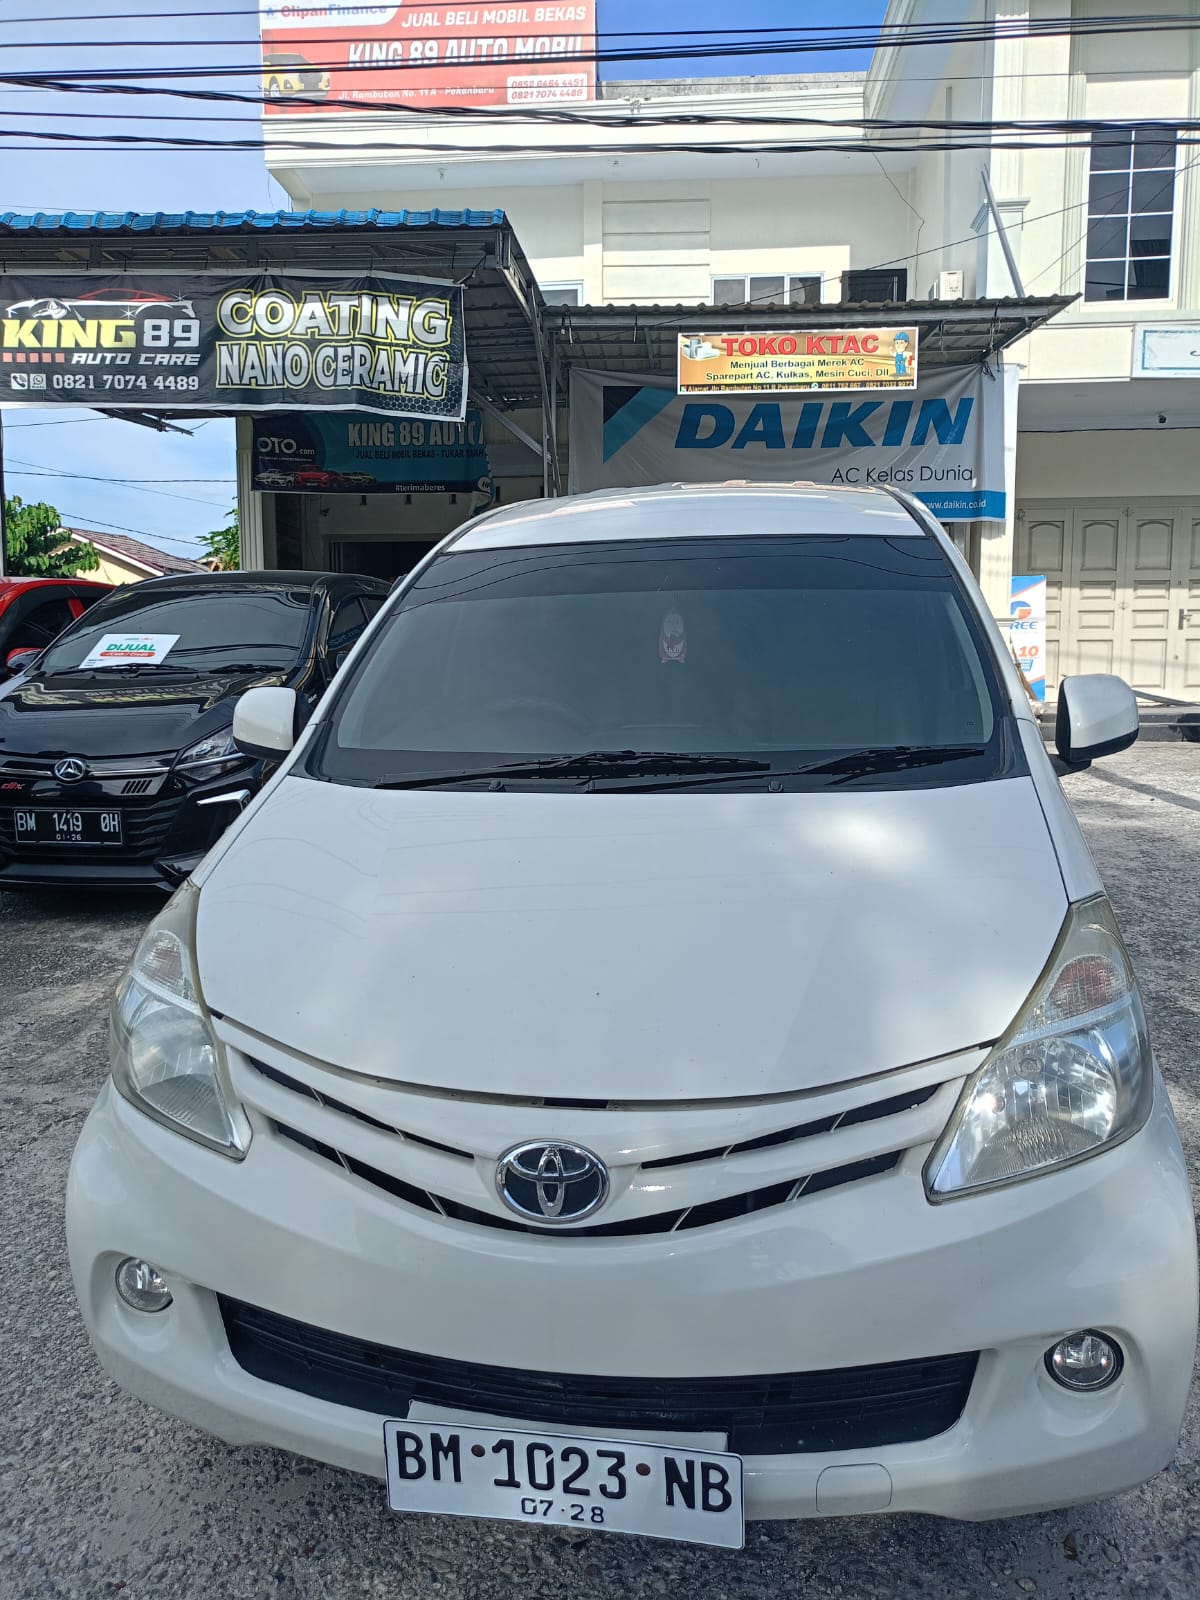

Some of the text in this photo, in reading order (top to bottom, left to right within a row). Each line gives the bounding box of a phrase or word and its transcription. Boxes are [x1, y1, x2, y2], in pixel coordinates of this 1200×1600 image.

[401, 6, 587, 27] JUAL BELI MOBIL BEKAS
[348, 41, 403, 68] KING
[408, 39, 440, 66] 89
[444, 37, 509, 64] AUTO
[217, 288, 453, 347] COATING
[2, 318, 200, 348] KING 89
[721, 334, 880, 357] TOKO KTAC
[72, 352, 201, 366] AUTO CARE
[730, 358, 865, 371] Menjual Berbagai Merek AC
[216, 341, 449, 400] NANO CERAMIC
[706, 370, 753, 381] Sparepart
[816, 369, 845, 378] Mesin
[53, 374, 199, 390] 0821 7074 4489
[675, 398, 975, 448] DAIKIN
[348, 423, 395, 447] KING
[399, 422, 425, 446] 89
[831, 465, 973, 483] AC Kelas Dunia
[395, 484, 446, 492] #terimaberes
[106, 643, 156, 651] DIJUAL
[1019, 645, 1039, 657] 10
[16, 813, 36, 831] BM
[53, 813, 83, 832] 1419
[396, 1430, 732, 1513] BM 1023 NB
